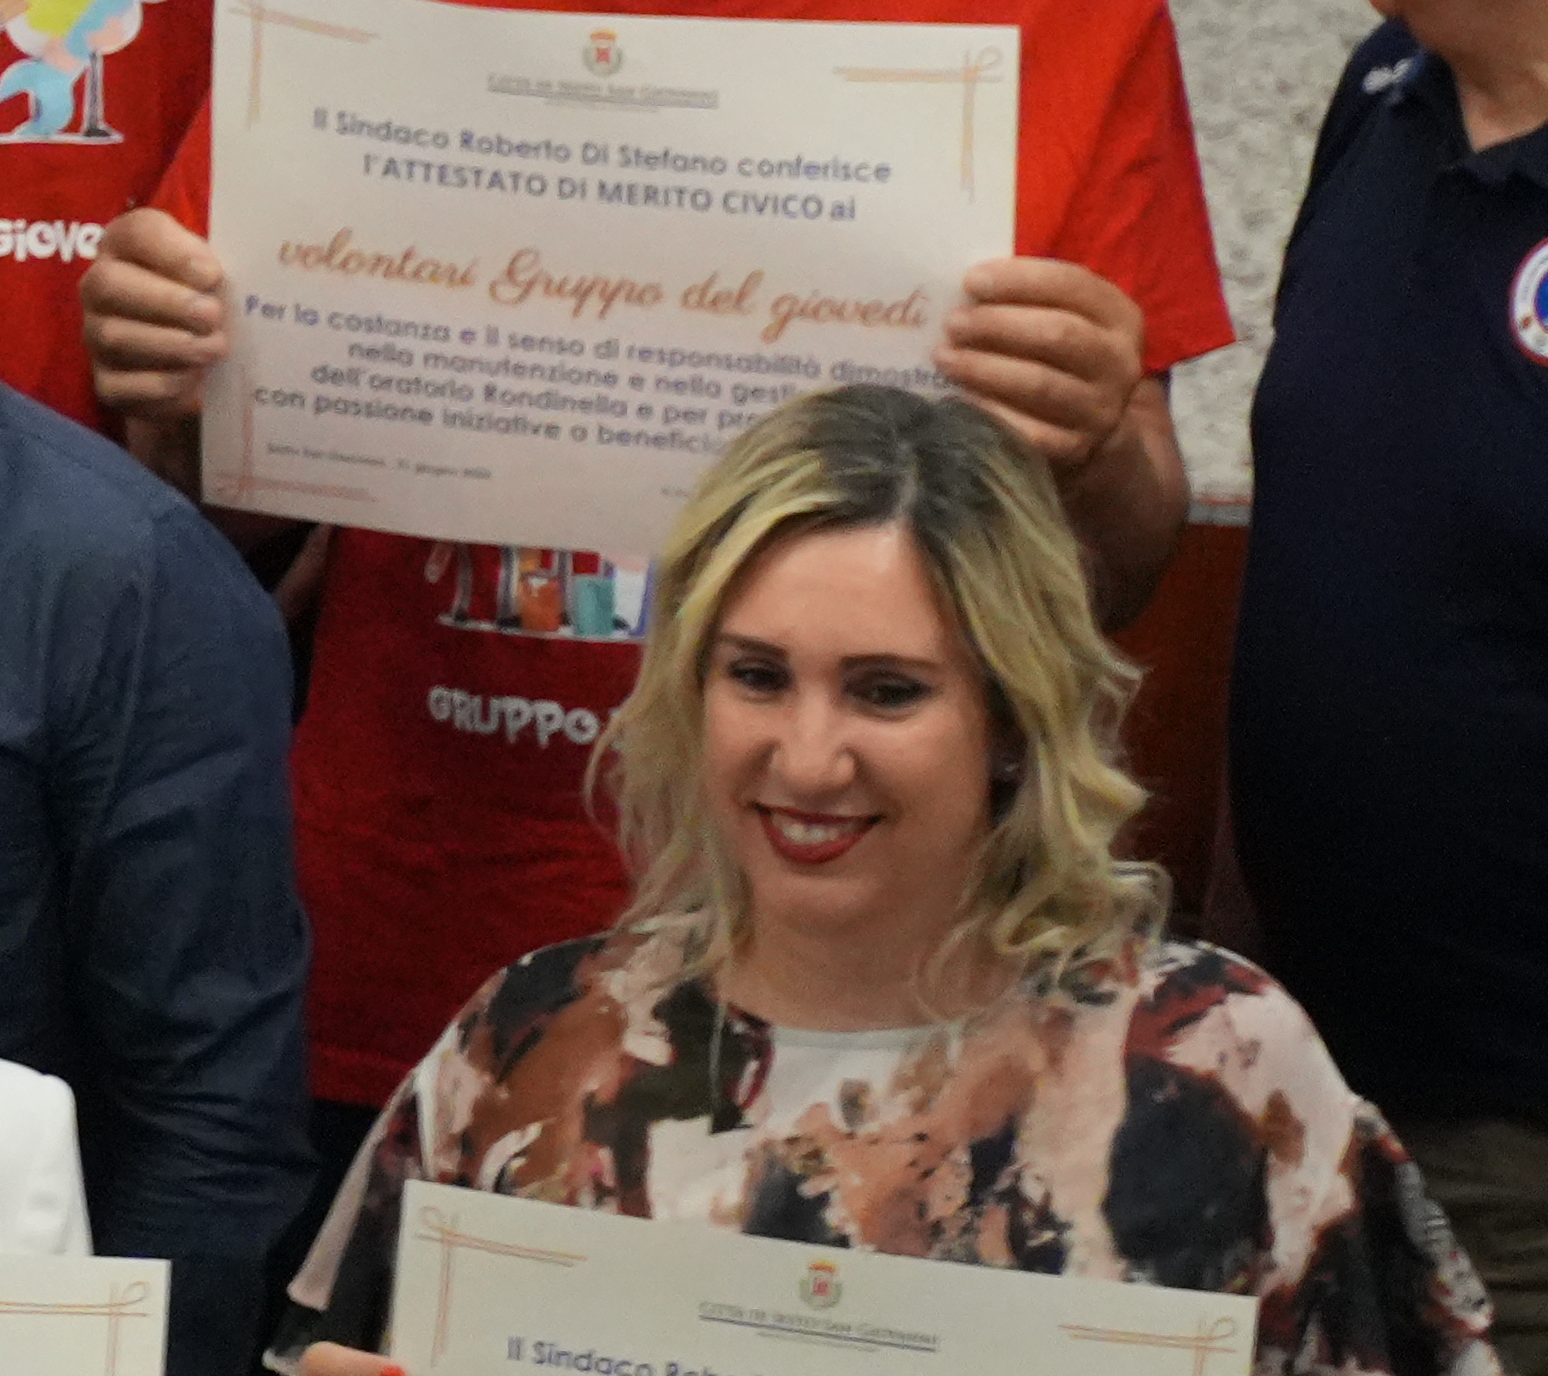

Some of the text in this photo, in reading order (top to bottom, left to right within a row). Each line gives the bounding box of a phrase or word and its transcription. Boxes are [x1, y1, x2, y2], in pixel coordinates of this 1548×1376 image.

[363, 153, 856, 222] l'ATTESTATO DI MERITO CIVICO ai
[278, 228, 930, 344] volontari Gruppo del giovedì
[507, 1336, 524, 1361] Il
